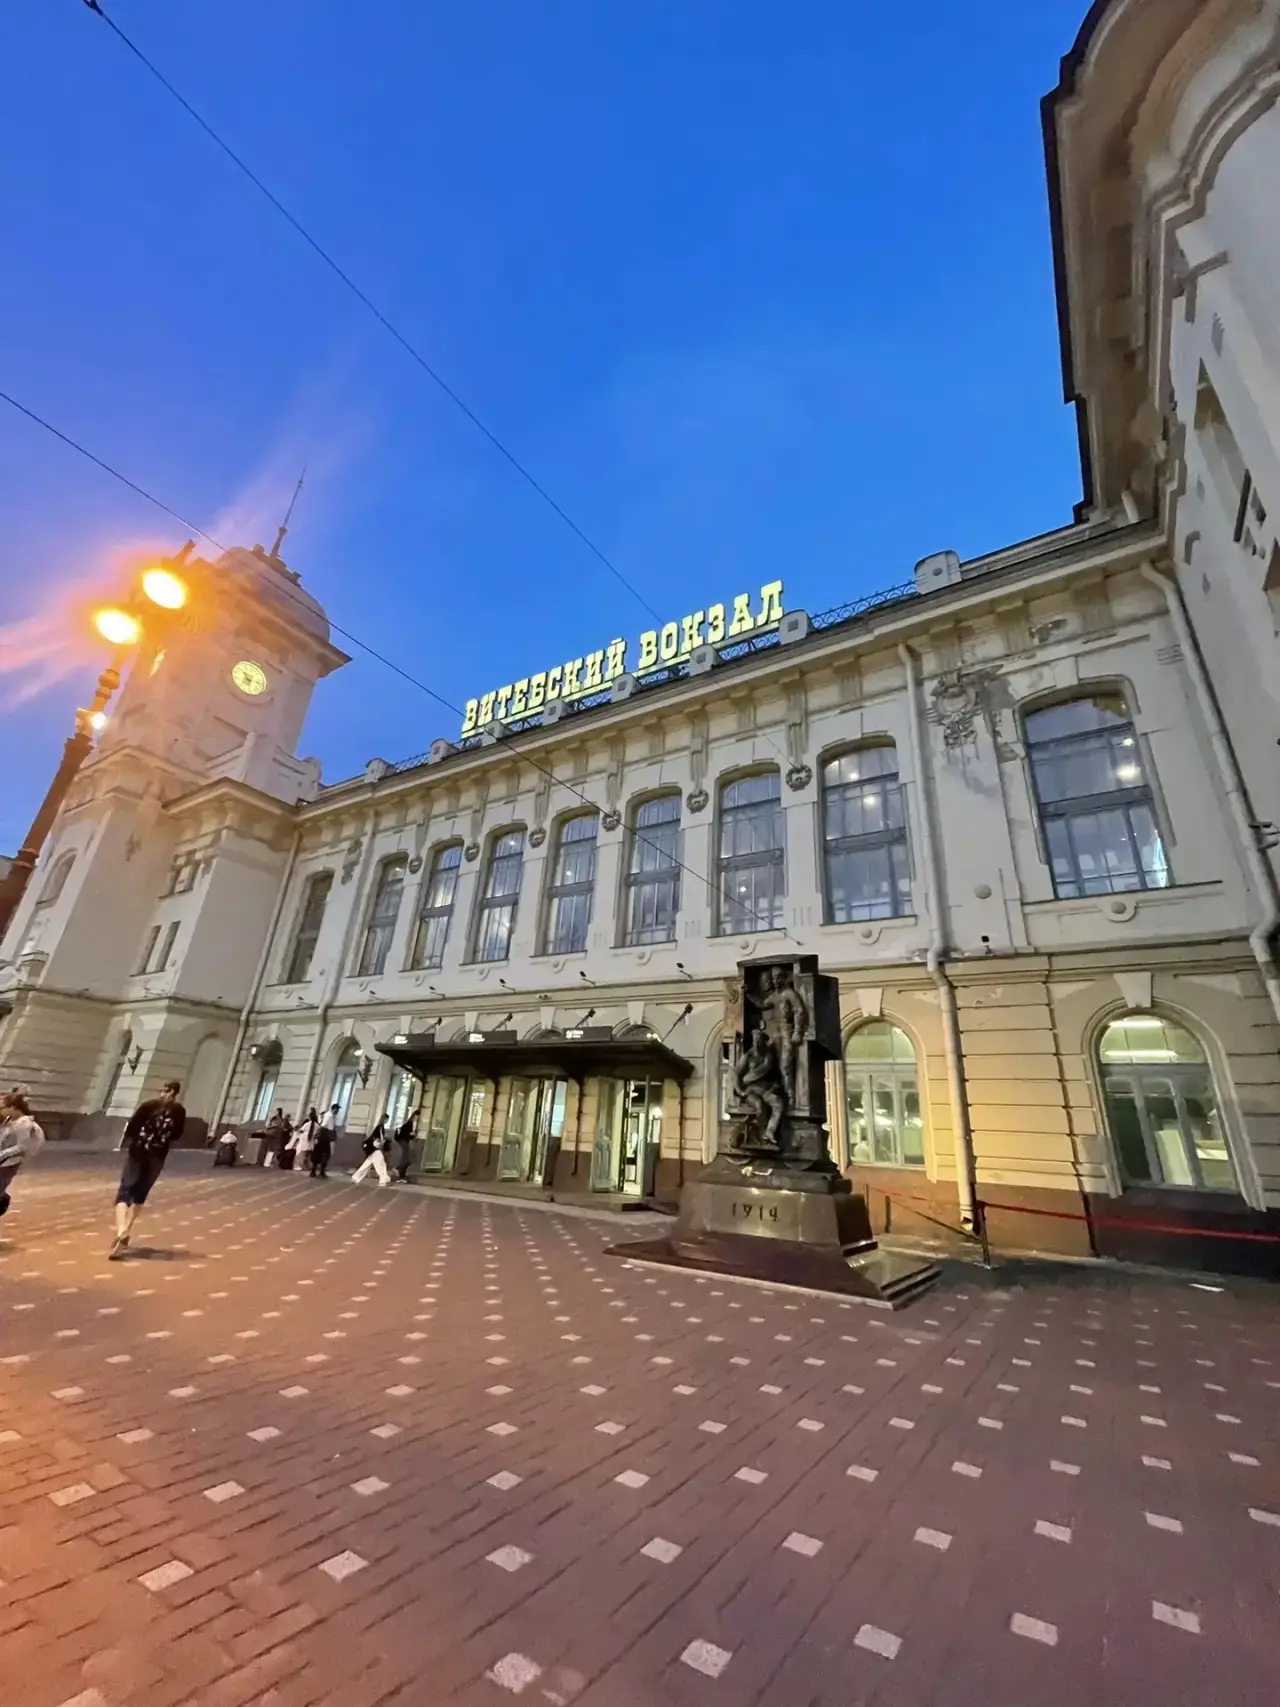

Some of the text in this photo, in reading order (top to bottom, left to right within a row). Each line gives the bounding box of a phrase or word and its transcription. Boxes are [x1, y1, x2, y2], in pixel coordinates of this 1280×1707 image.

[461, 579, 784, 732] ВИТЕБСКИЙ ВОКЗАЛ
[732, 1202, 778, 1222] 1914
